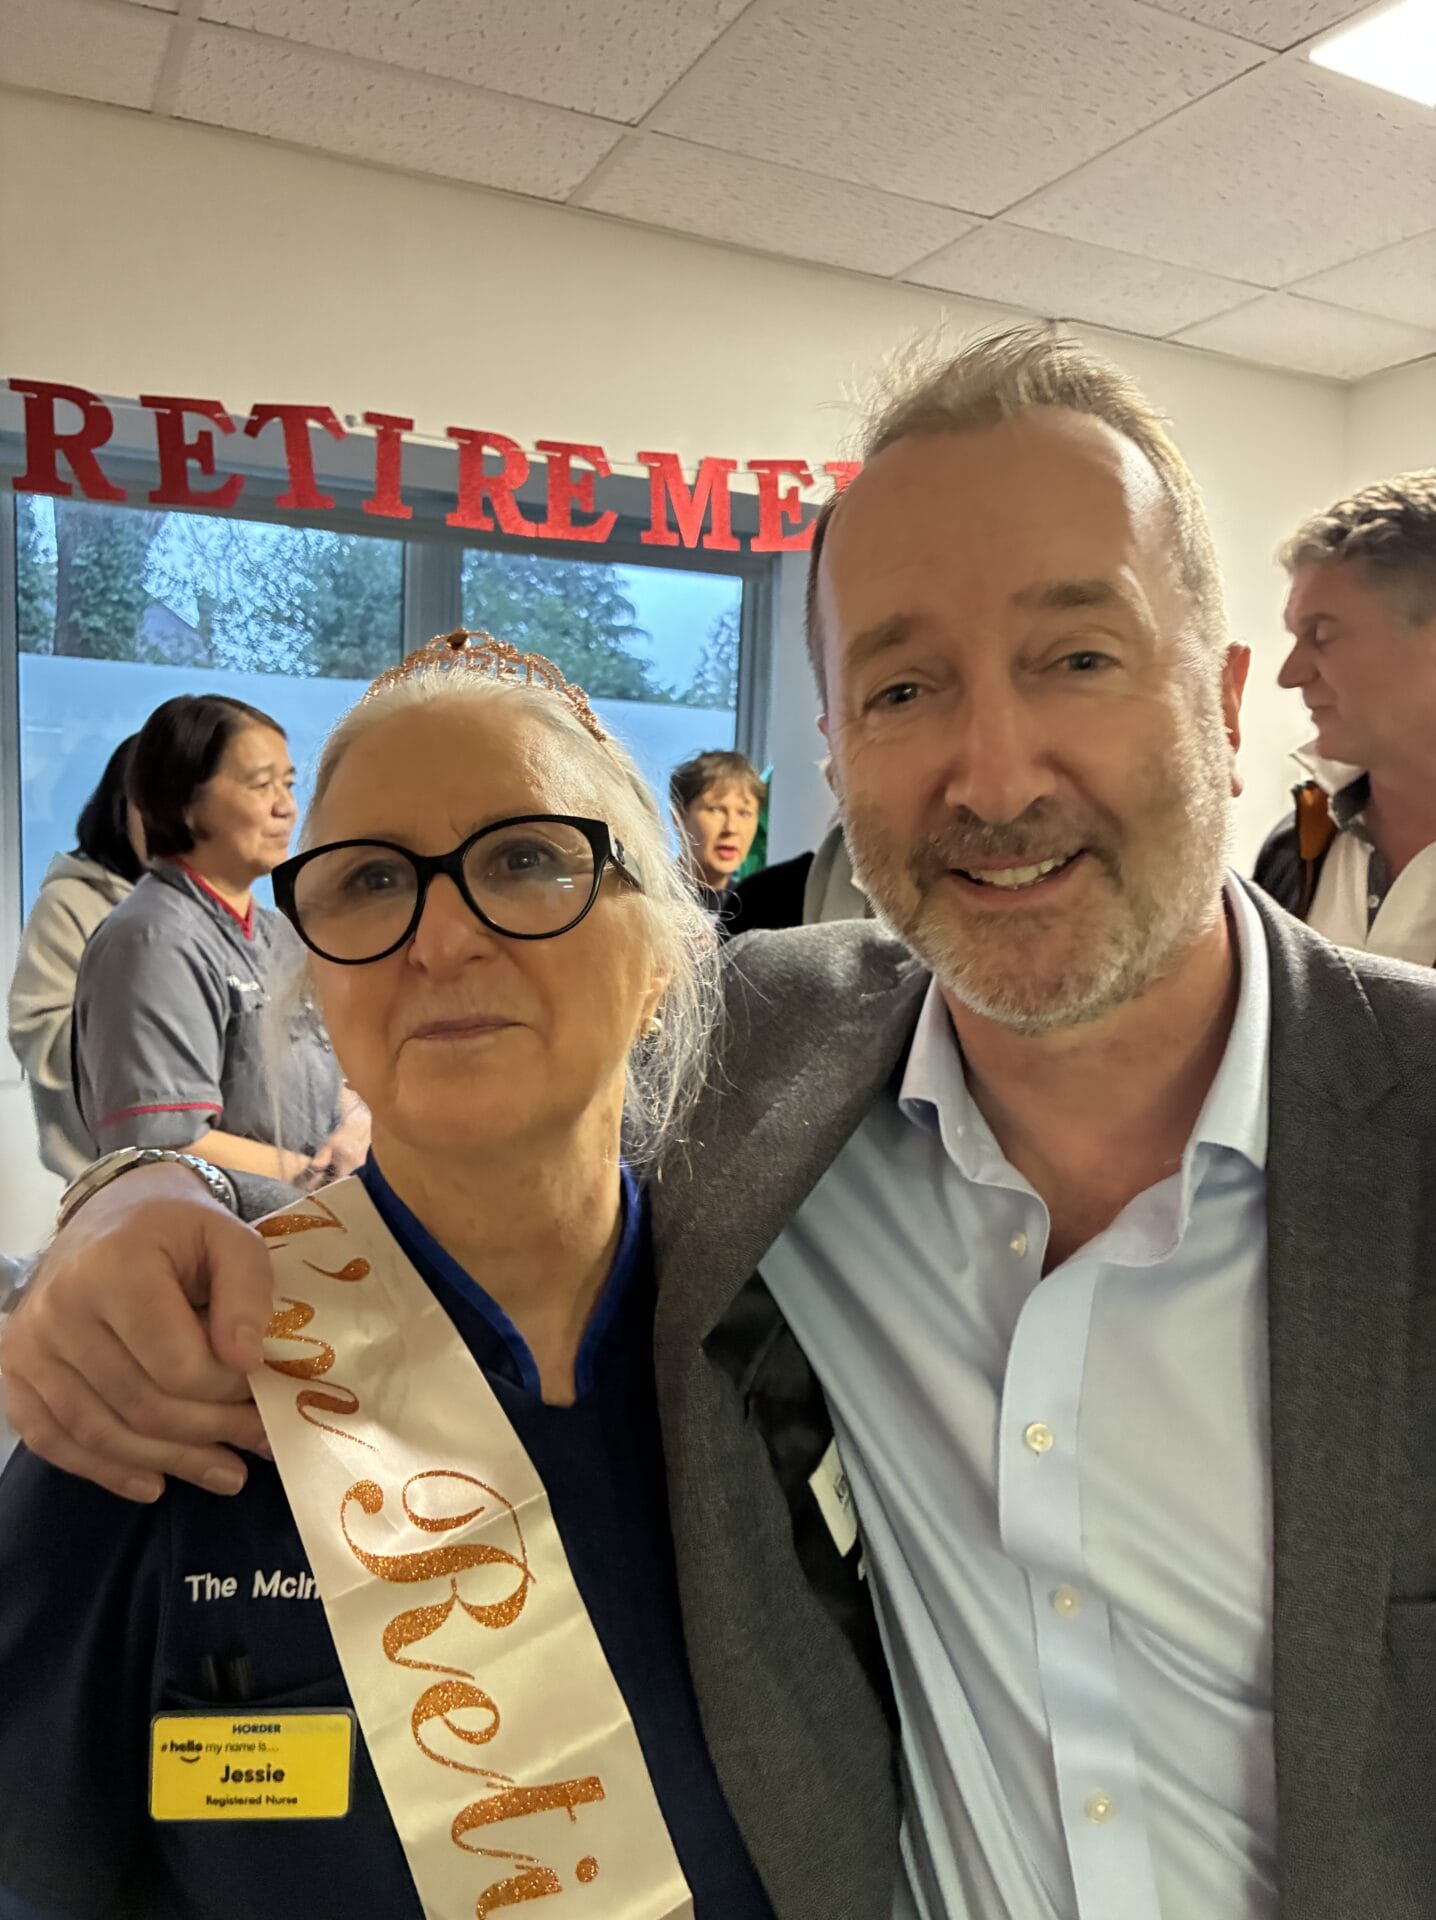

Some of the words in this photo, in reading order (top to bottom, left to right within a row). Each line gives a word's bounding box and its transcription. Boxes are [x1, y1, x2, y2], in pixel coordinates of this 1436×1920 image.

[8, 378, 863, 552] RETIREME
[185, 1572, 238, 1602] The
[232, 1723, 281, 1735] HORDER
[205, 1744, 221, 1754] my
[225, 1742, 256, 1752] name
[220, 1763, 285, 1783] Jessie
[206, 1794, 262, 1807] Registered
[266, 1795, 298, 1805] Nurse
